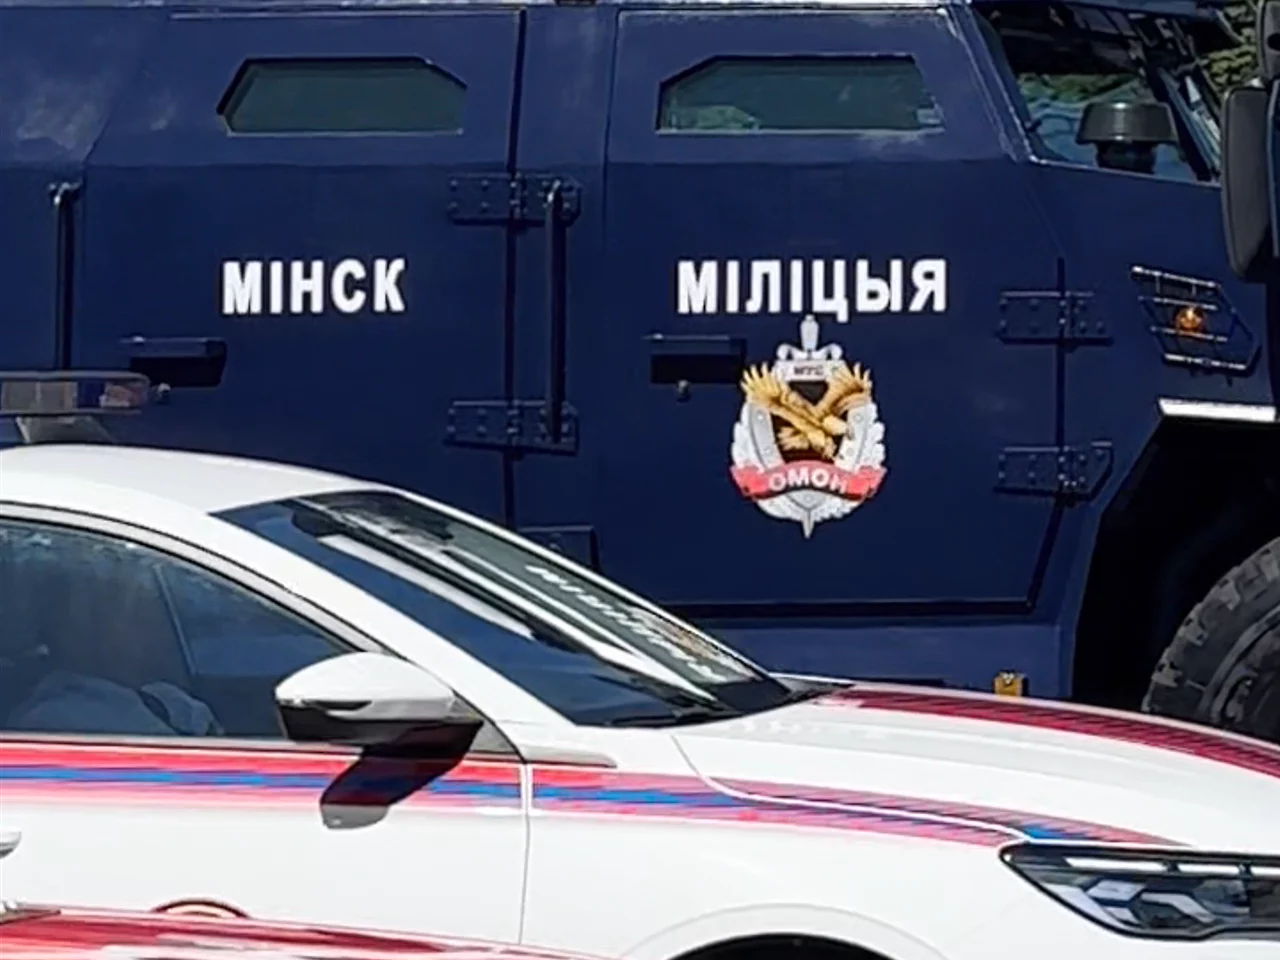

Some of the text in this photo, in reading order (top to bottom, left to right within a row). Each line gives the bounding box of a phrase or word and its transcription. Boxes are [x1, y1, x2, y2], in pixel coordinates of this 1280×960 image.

[223, 258, 405, 314] МІНСК
[678, 258, 947, 322] МІЛІЦЫЯ
[768, 467, 849, 493] ОМОН
